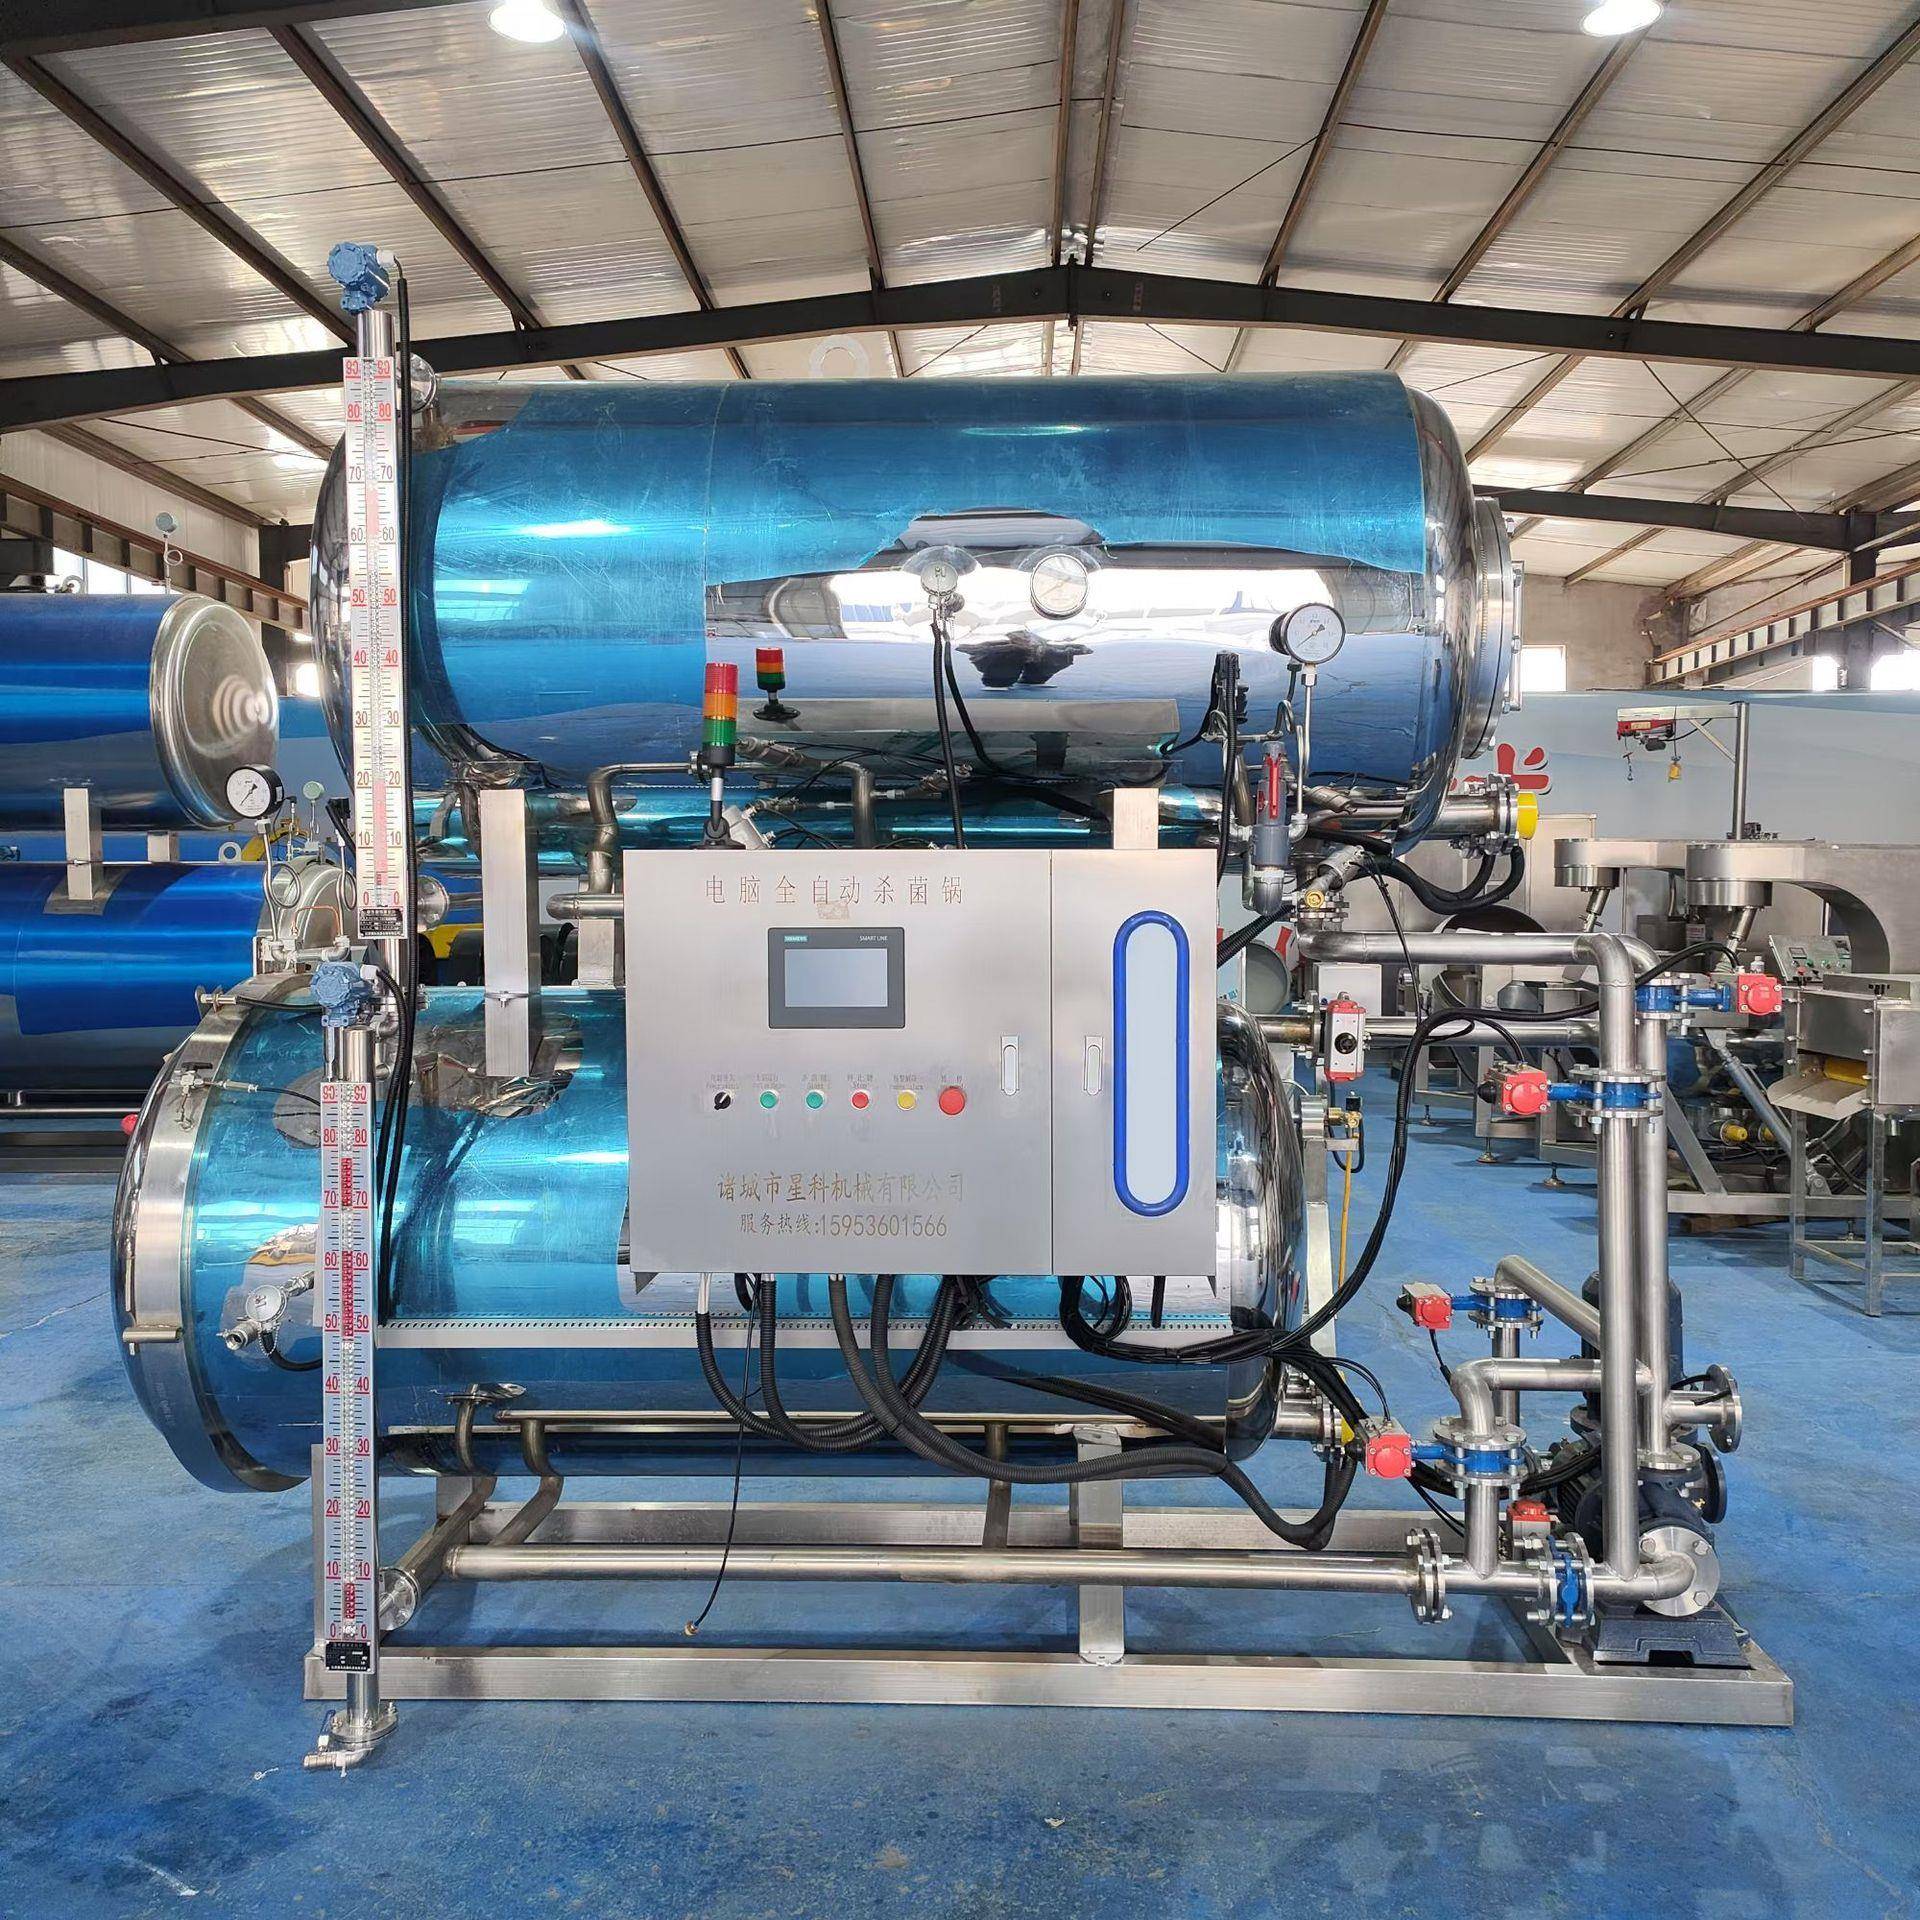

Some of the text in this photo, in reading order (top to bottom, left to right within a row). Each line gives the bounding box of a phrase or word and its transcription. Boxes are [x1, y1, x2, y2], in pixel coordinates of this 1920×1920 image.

[347, 404, 361, 418] 80
[378, 403, 392, 417] 80
[349, 466, 362, 480] 70
[380, 465, 393, 479] 70
[350, 528, 364, 542] 60
[382, 526, 395, 541] 60
[352, 589, 365, 603] 50
[383, 588, 397, 602] 50
[353, 652, 367, 665] 40
[385, 652, 398, 664] 40
[355, 711, 368, 725] 30
[387, 711, 400, 724] 30
[357, 771, 370, 786] 20
[388, 771, 401, 785] 20
[358, 831, 371, 846] 10
[390, 831, 402, 845] 10
[705, 875, 963, 905] 电脑全自动杀菌锅
[362, 891, 370, 906] 0
[393, 891, 400, 905] 0
[323, 1129, 336, 1143] 80
[354, 1129, 368, 1143] 80
[717, 1171, 965, 1203] 诸城市星科机械有限公司
[324, 1191, 337, 1205] 70
[355, 1191, 368, 1205] 70
[324, 1252, 338, 1267] 60
[355, 1252, 368, 1267] 60
[325, 1314, 338, 1329] 50
[356, 1314, 369, 1329] 50
[325, 1377, 339, 1391] 40
[356, 1377, 370, 1391] 40
[326, 1438, 339, 1453] 30
[357, 1438, 370, 1453] 30
[326, 1500, 339, 1514] 20
[357, 1500, 370, 1514] 20
[326, 1562, 339, 1576] 10
[357, 1562, 370, 1576] 10
[330, 1623, 337, 1638] 0
[360, 1624, 367, 1639] 0
